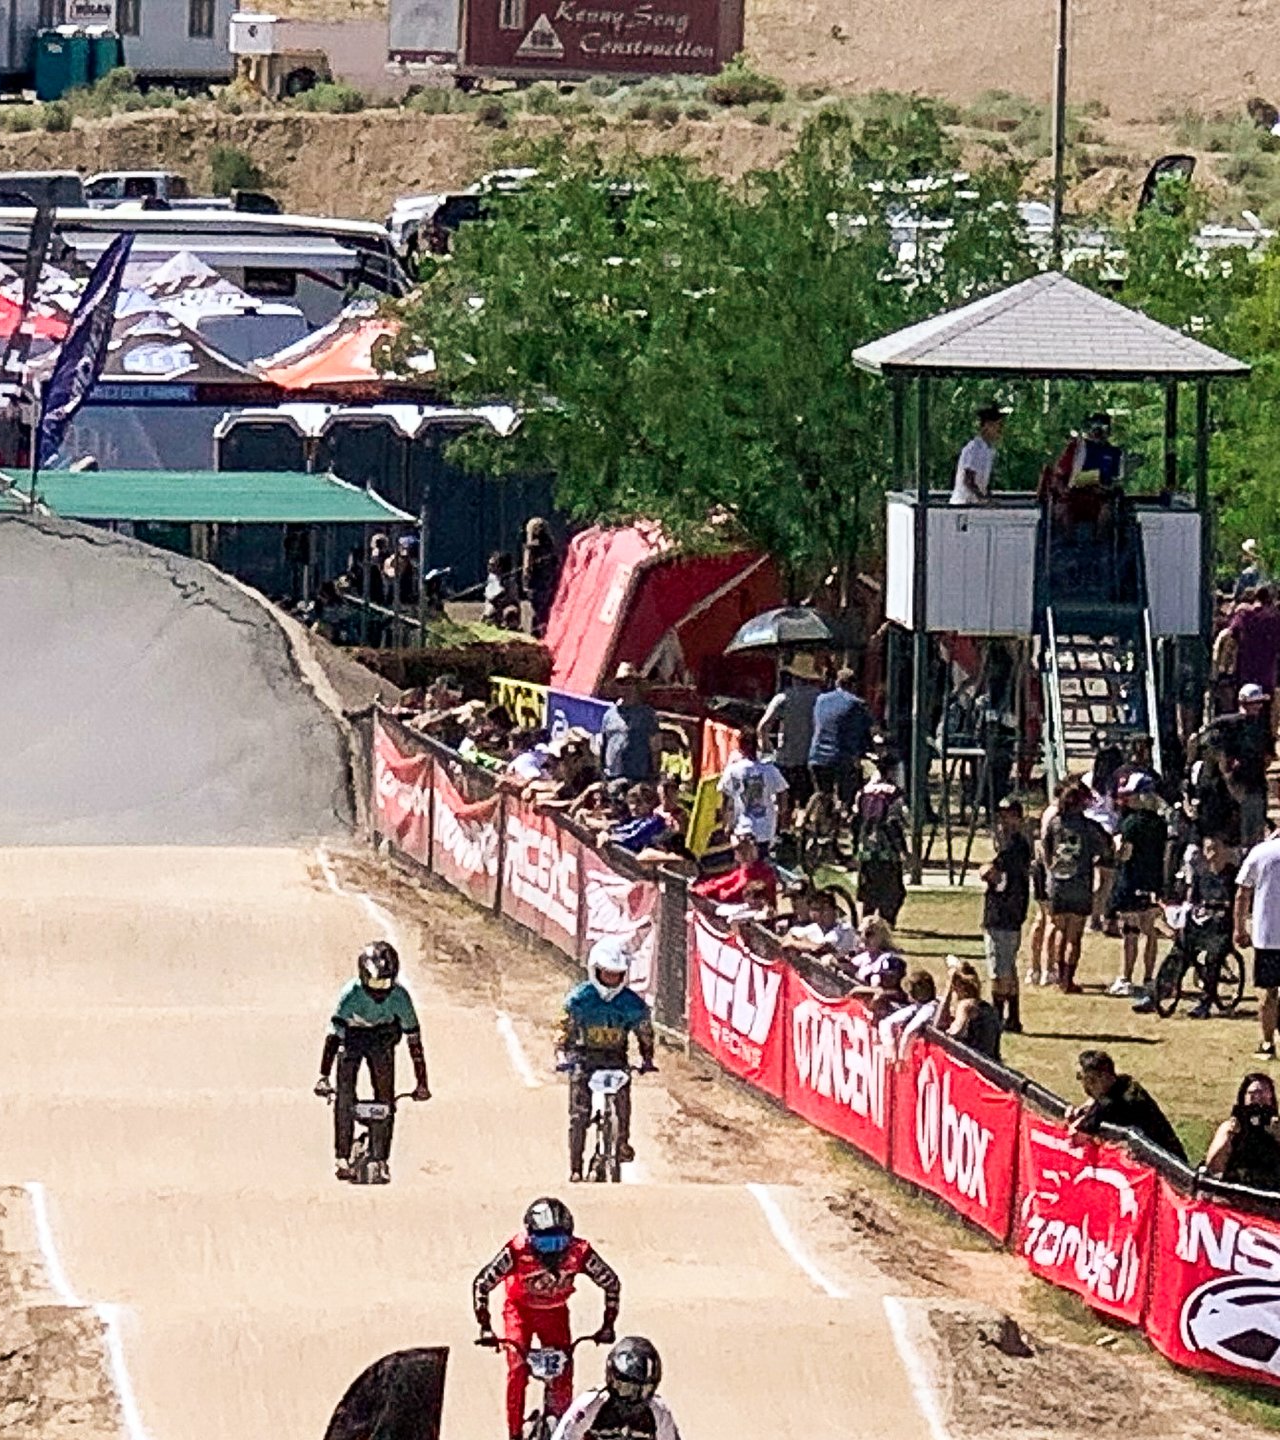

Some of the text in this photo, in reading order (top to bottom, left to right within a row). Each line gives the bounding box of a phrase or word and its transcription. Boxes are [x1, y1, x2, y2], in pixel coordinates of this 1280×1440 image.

[555, 2, 624, 31] Kenny
[579, 31, 714, 57] Construction
[694, 919, 784, 1046] FLY
[939, 1101, 992, 1208] box
